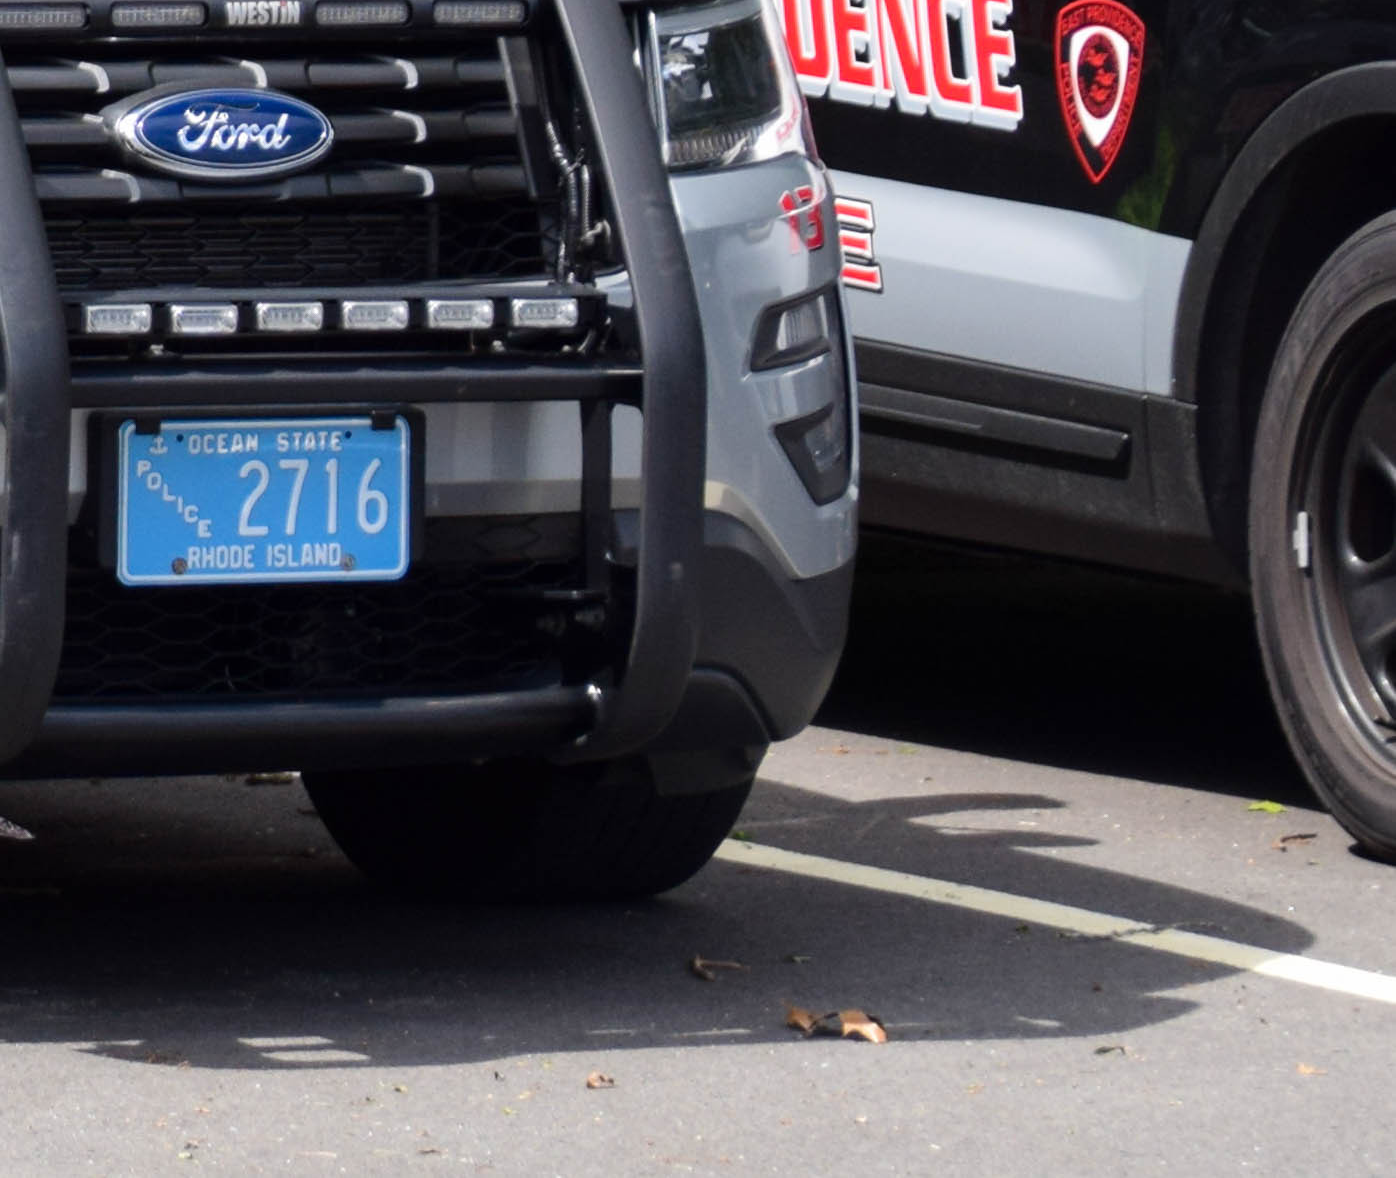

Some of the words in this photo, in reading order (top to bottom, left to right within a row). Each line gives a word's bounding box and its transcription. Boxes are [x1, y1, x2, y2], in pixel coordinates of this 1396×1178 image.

[177, 102, 291, 152] Ford
[777, 185, 825, 252] 13
[188, 433, 259, 455] OCEAN
[277, 431, 343, 452] STATE
[137, 459, 213, 539] POLICE
[237, 458, 389, 537] 2716
[187, 544, 256, 570] RHODE
[267, 542, 342, 568] ISLAND
